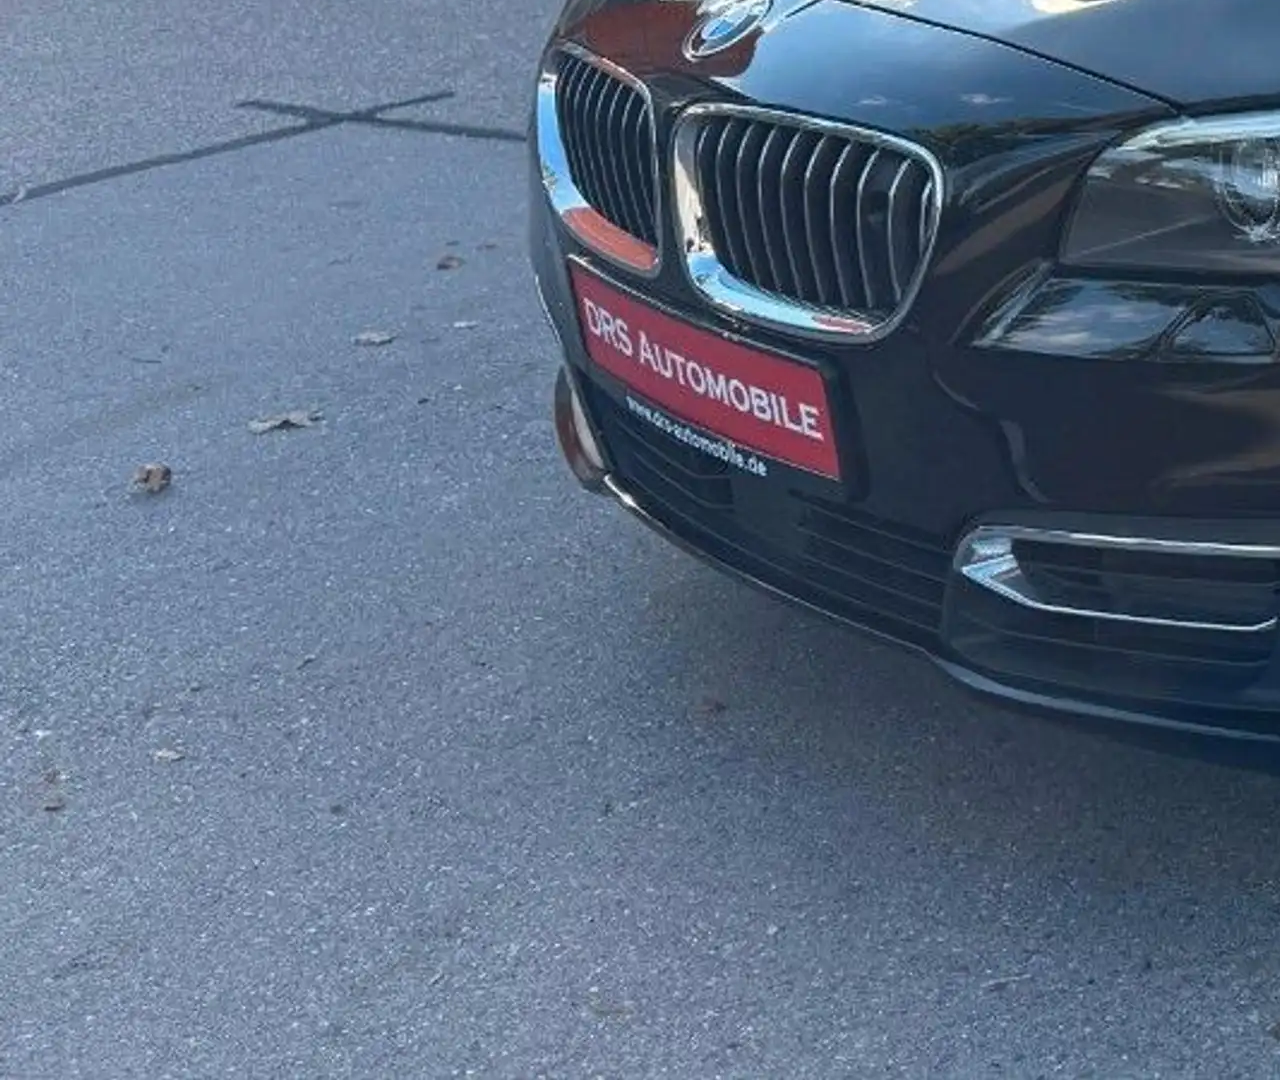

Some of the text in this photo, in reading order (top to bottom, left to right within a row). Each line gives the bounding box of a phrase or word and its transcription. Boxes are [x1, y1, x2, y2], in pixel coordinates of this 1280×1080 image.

[583, 296, 825, 442] DRS AUTOMOBILE
[625, 395, 769, 477] www.drs-automobile.de
